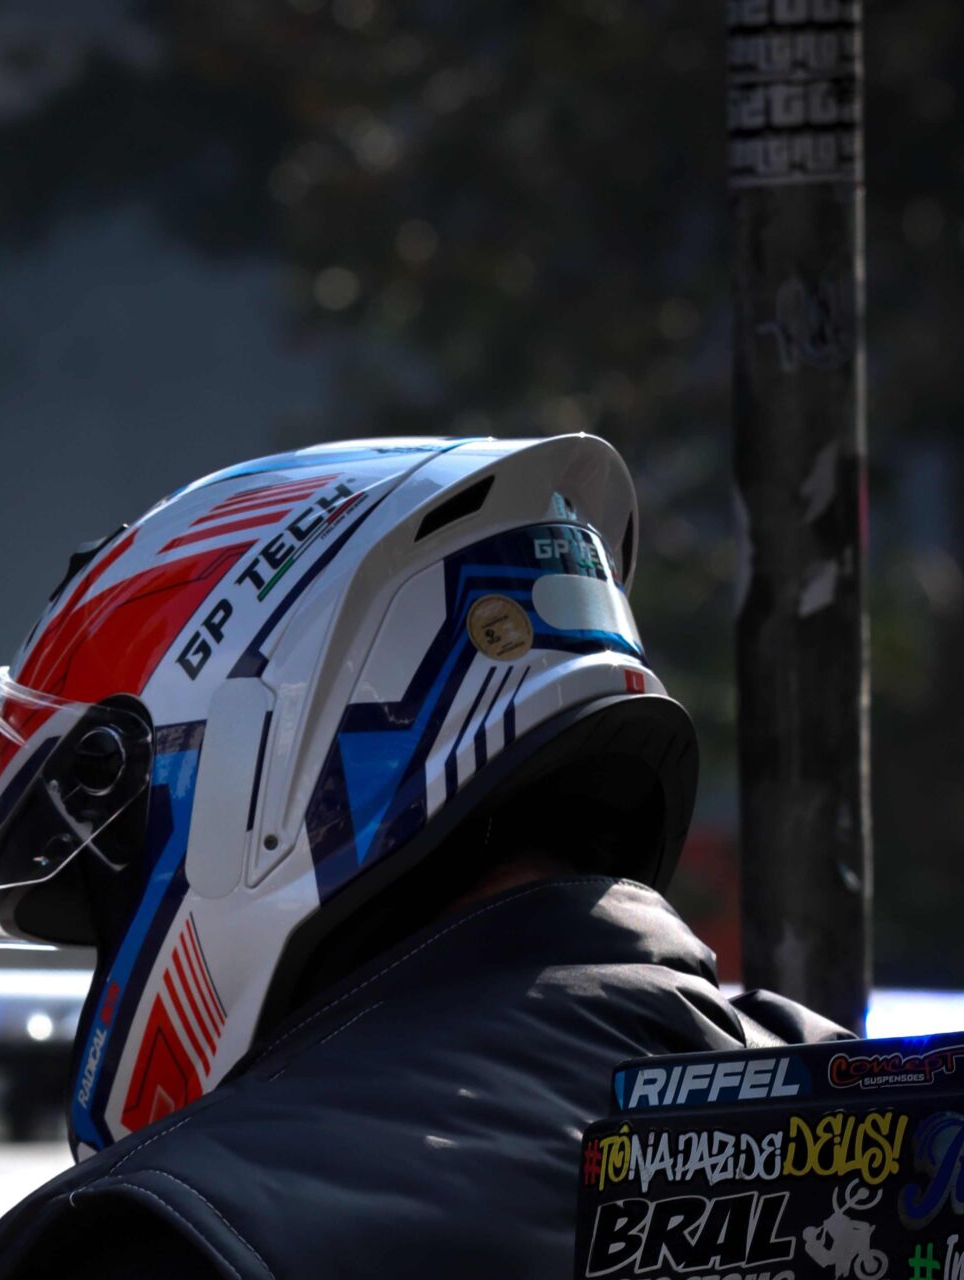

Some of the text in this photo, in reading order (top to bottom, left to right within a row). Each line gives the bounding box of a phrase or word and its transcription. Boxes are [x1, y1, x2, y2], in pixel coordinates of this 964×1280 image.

[176, 599, 233, 680] GP
[235, 484, 354, 590] TECH
[534, 539, 569, 559] GP
[78, 1028, 107, 1109] RADICAL
[628, 1057, 800, 1109] RIFFEL
[586, 1191, 796, 1278] BRAL
